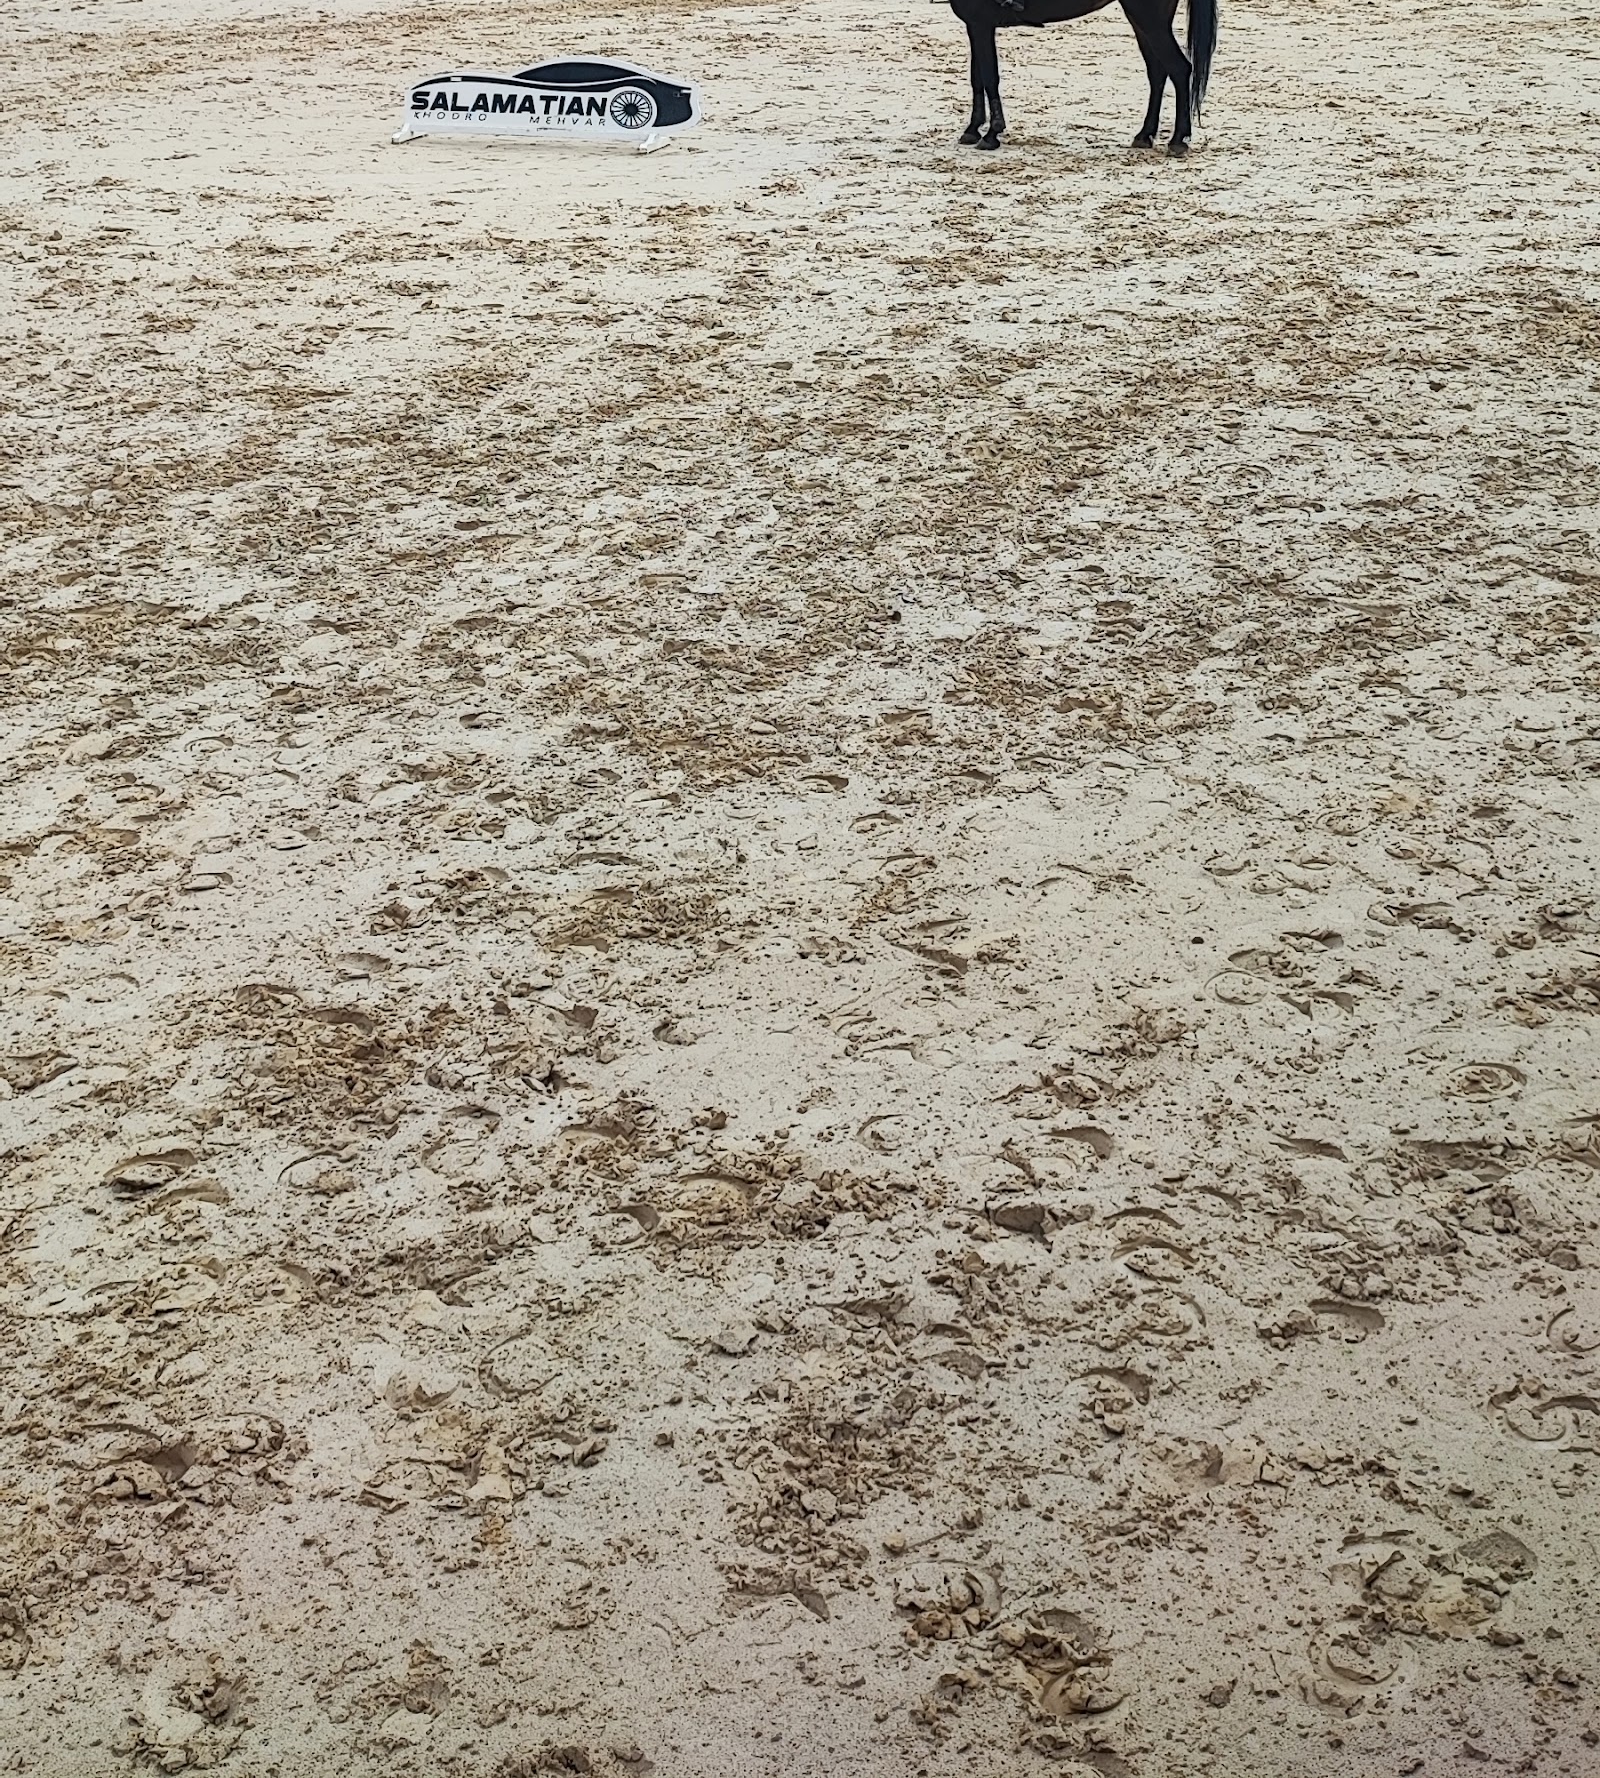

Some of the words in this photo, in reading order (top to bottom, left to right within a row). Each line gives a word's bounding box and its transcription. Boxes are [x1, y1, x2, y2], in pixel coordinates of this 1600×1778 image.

[410, 91, 608, 117] SALAMATIAN
[413, 110, 488, 122] KHODRO
[529, 115, 606, 127] MEHVAR
